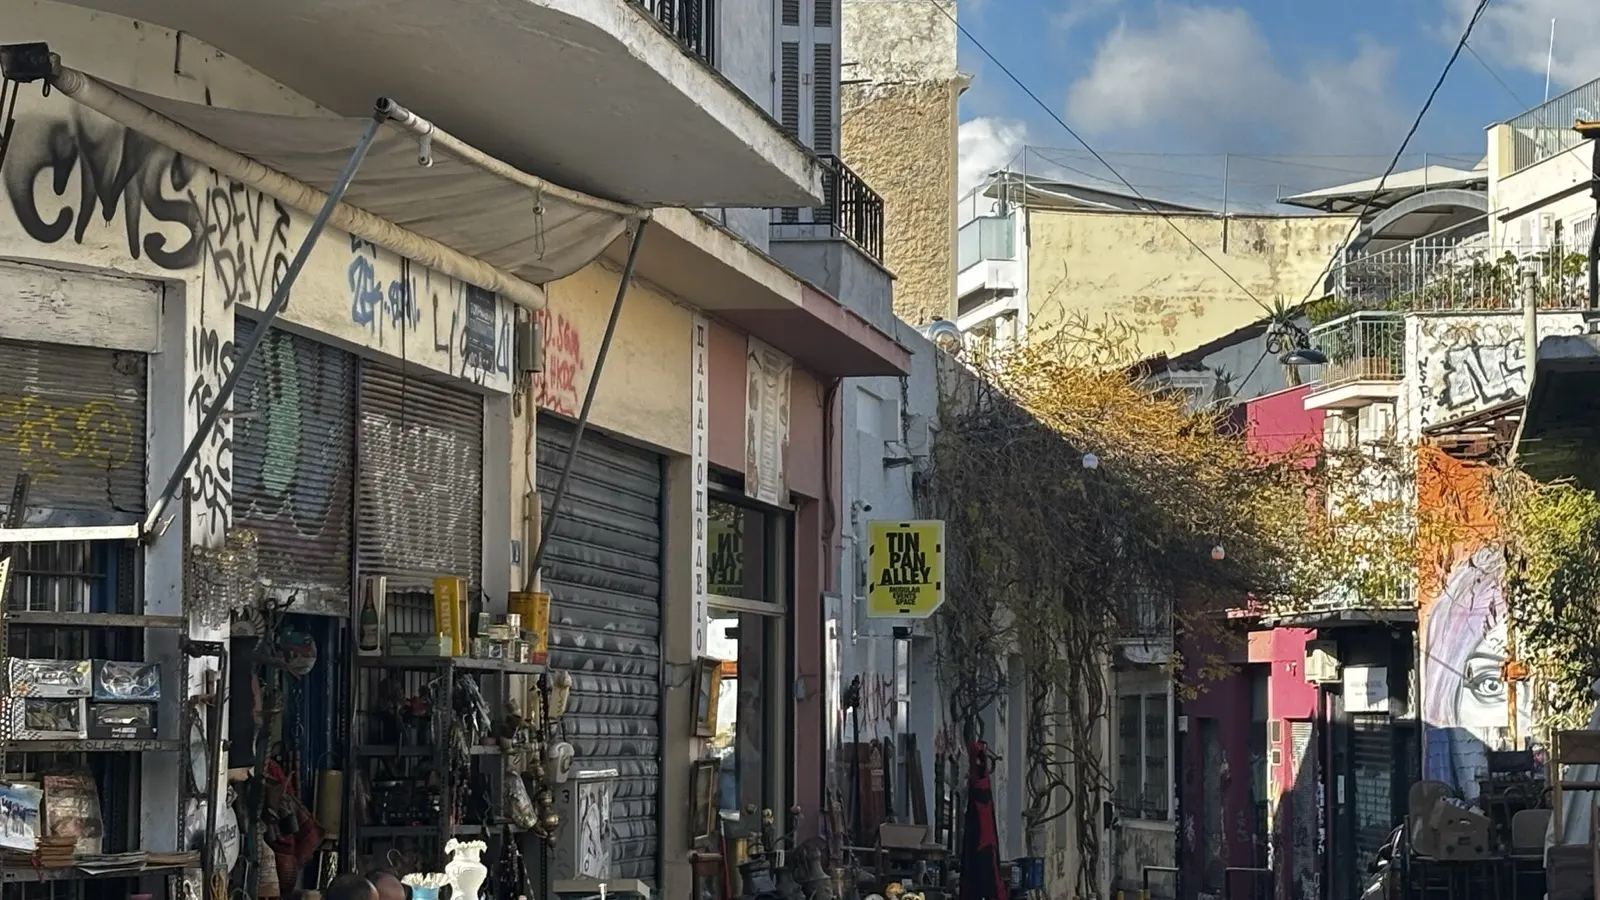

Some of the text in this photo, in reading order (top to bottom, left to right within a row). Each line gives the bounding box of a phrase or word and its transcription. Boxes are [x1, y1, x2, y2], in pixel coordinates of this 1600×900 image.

[5, 118, 203, 270] CMS
[886, 532, 920, 552] TIN
[890, 552, 926, 568] PAN
[880, 567, 931, 586] ALLEY
